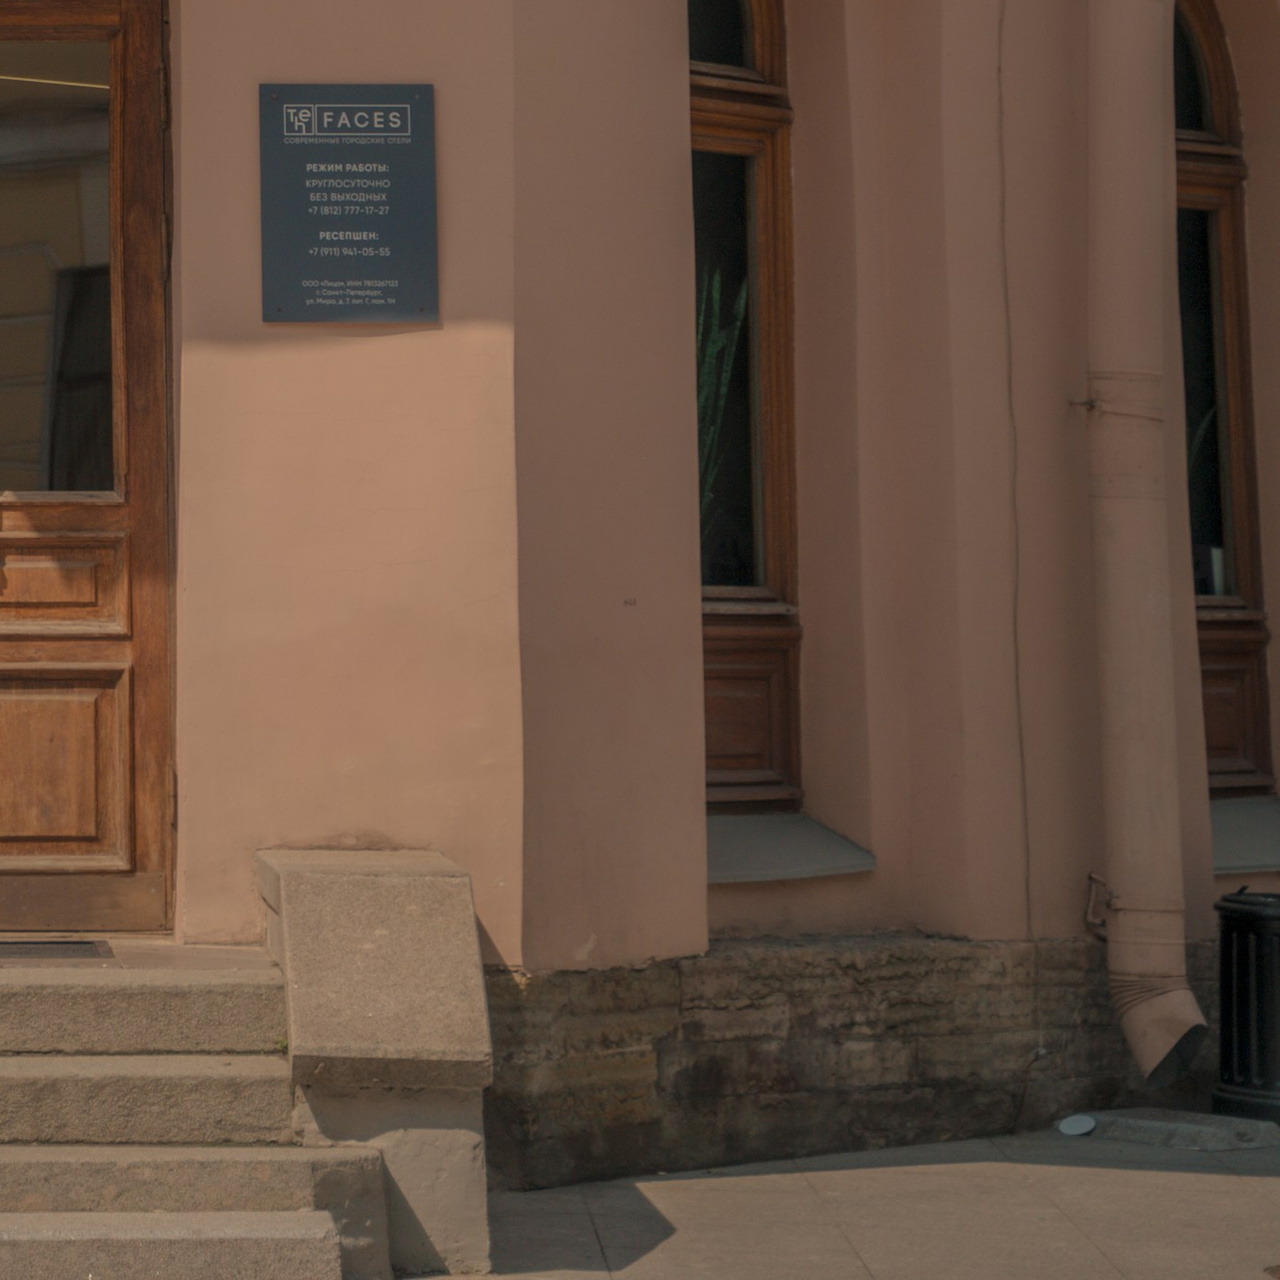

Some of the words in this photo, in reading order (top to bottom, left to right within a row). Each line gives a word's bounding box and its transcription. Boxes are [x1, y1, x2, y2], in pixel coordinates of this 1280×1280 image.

[323, 112, 401, 128] FACES
[306, 163, 343, 172] РЕЖИМ
[346, 163, 389, 172] РАБОТЫ:
[305, 179, 391, 188] КРУГЛОСУТОЧНО
[310, 193, 328, 201] БЕЗ
[330, 193, 387, 202] ВЫХОДНЫХ
[308, 206, 318, 214] +7
[320, 205, 342, 215] (812)
[344, 206, 390, 215] 777-17-27
[319, 231, 379, 240] РЕСЕПШЕН:
[309, 247, 318, 256] +7
[320, 247, 340, 257] (911)
[342, 247, 391, 256] 941-05-55
